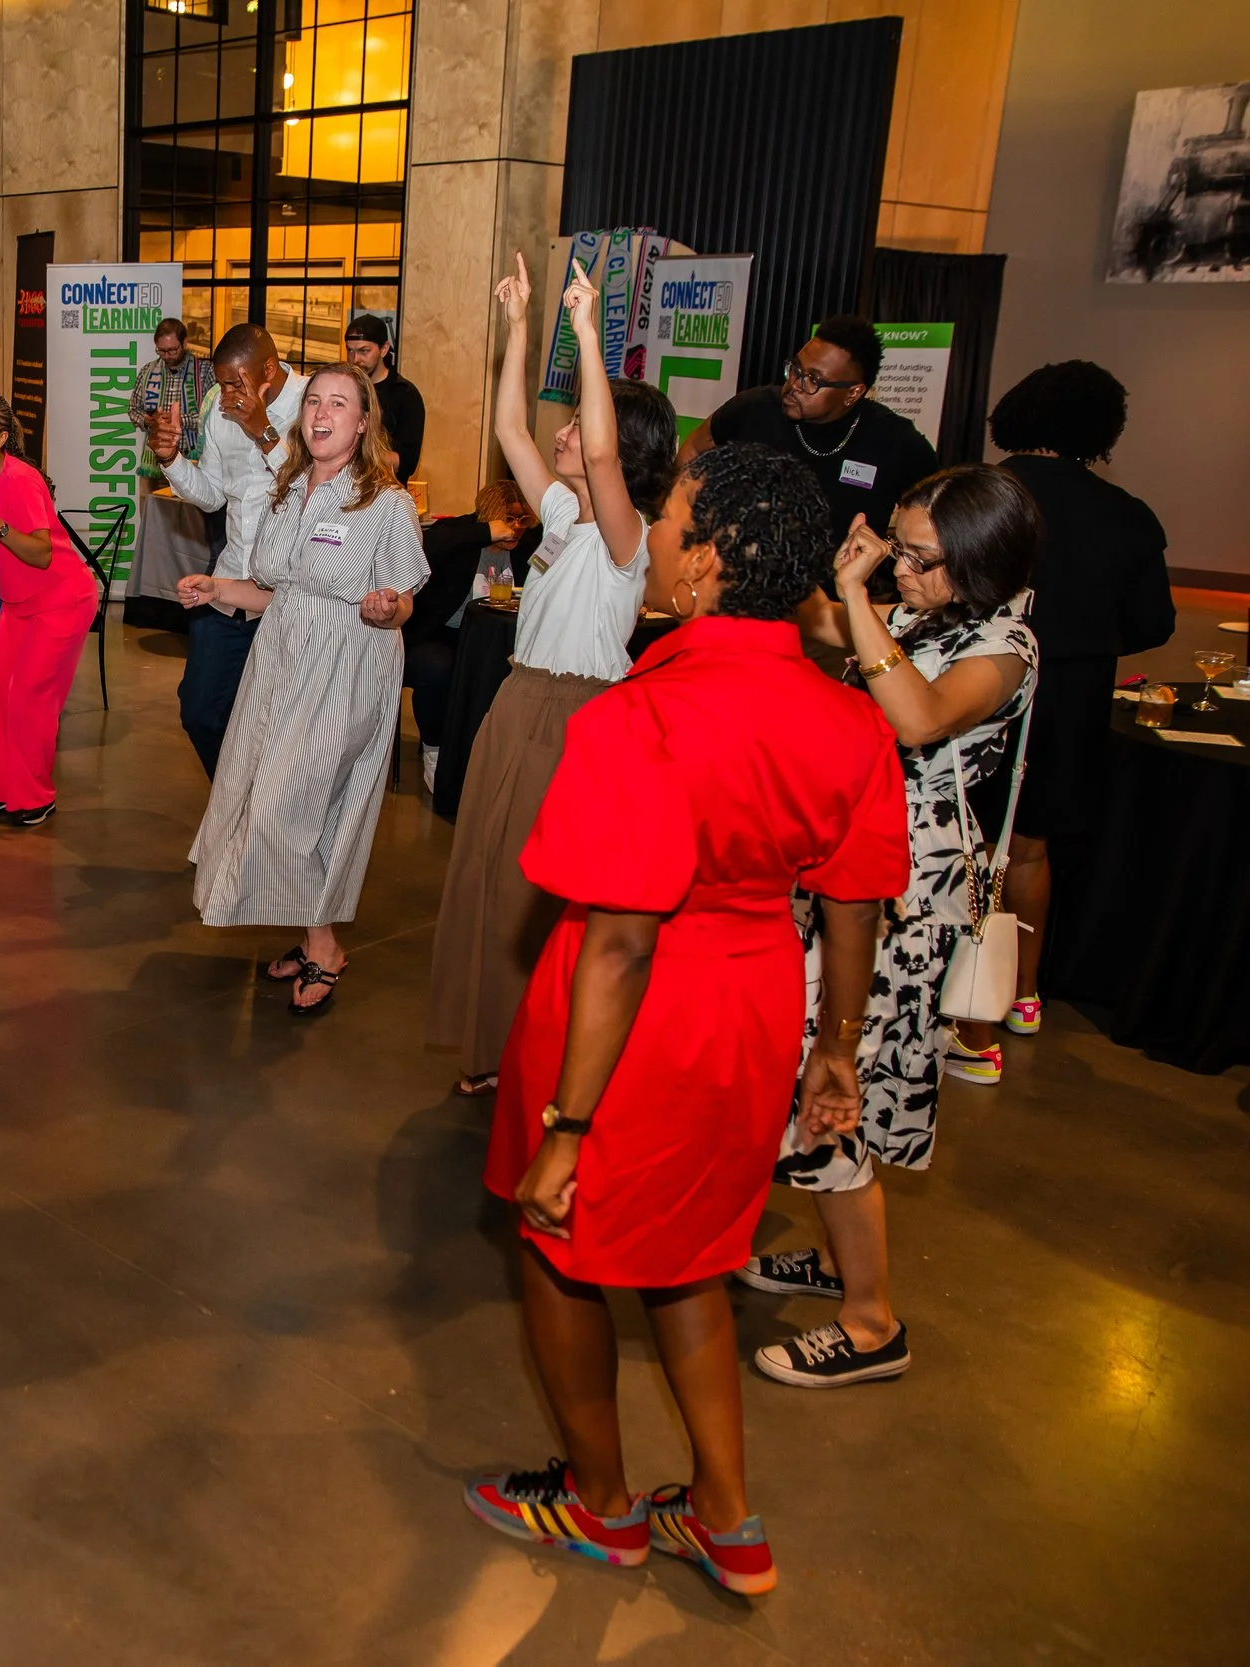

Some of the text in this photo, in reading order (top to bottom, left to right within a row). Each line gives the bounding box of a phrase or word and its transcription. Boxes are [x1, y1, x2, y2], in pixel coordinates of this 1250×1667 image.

[61, 280, 162, 309] CONNECTED
[637, 245, 660, 331] 4/25/26
[661, 280, 733, 315] CONNECTED
[83, 304, 162, 334] LEARNING
[673, 308, 730, 346] LEARNING
[882, 331, 928, 341] KNOW?
[912, 375, 924, 384] by
[89, 341, 137, 581] TRANSFORM
